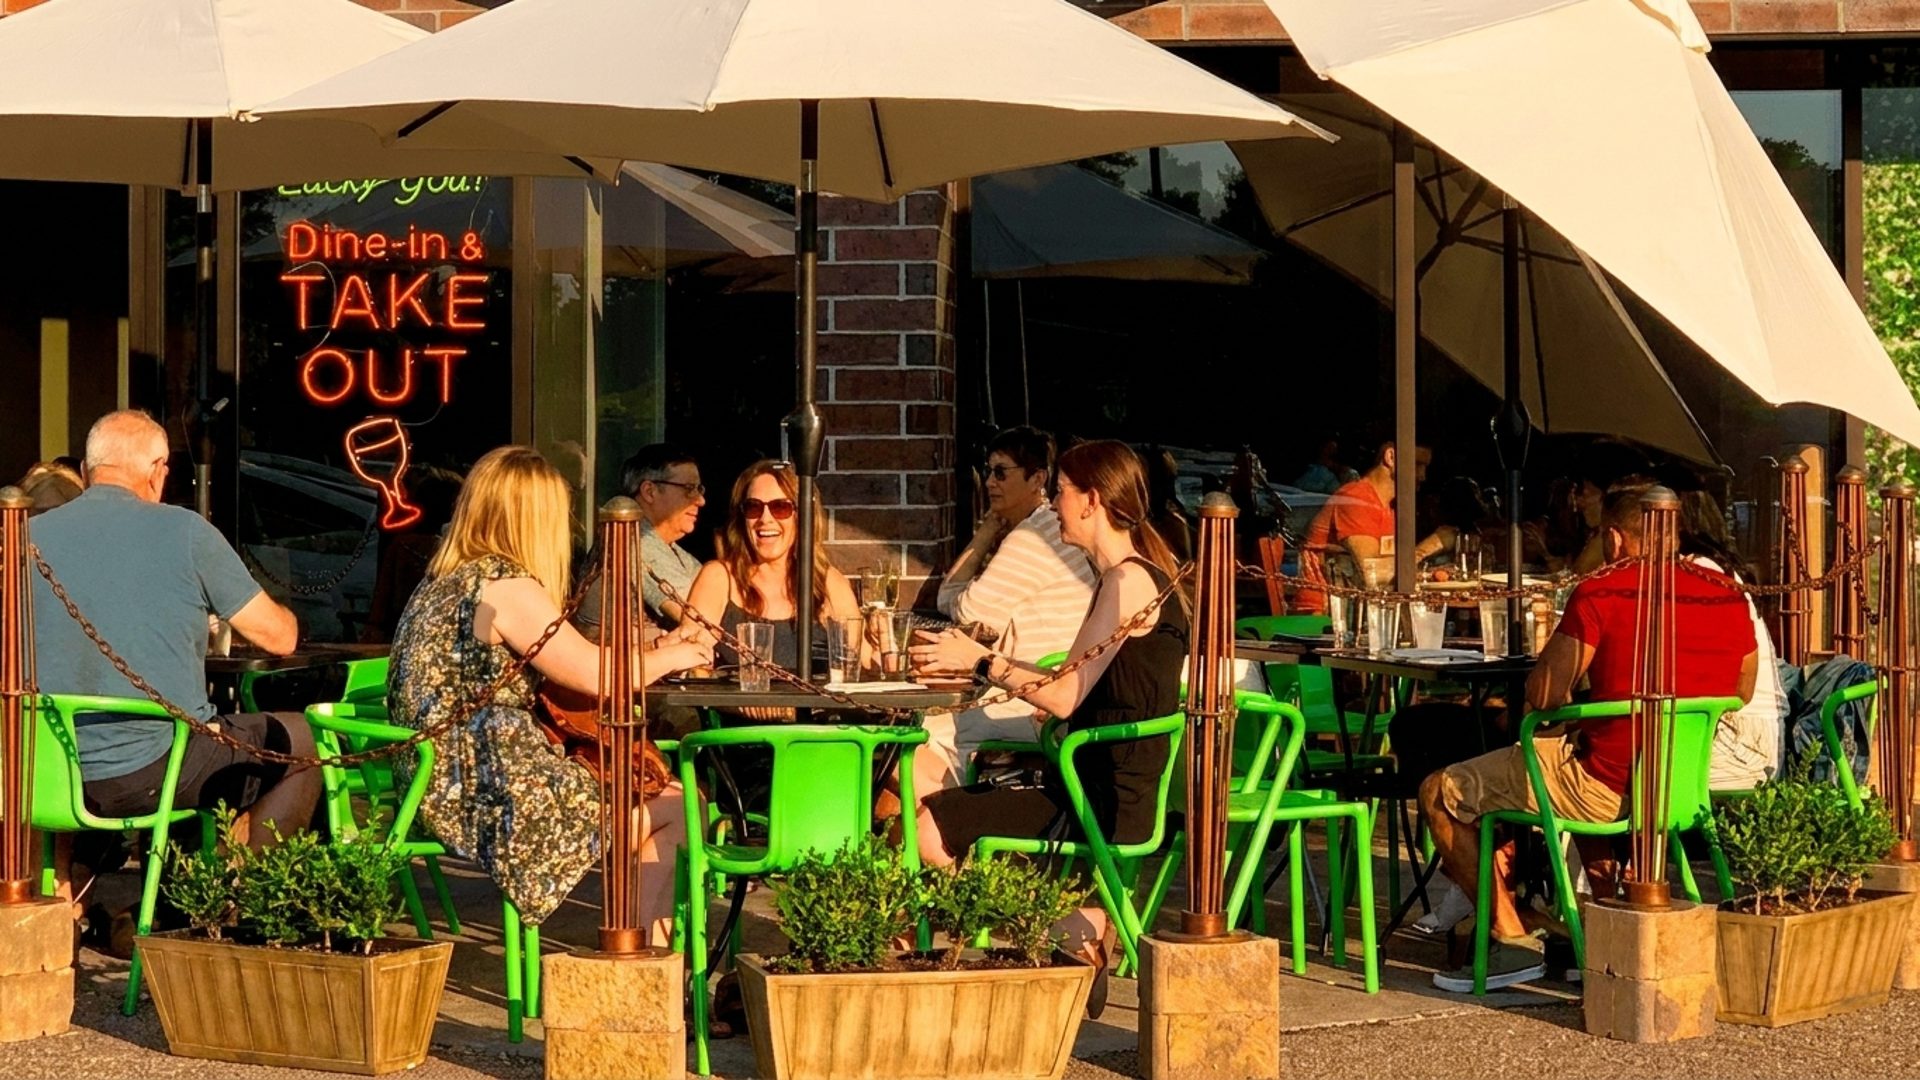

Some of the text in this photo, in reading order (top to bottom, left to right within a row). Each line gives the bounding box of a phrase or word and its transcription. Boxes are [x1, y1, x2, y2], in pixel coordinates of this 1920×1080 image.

[288, 223, 485, 261] Dine-in &
[280, 272, 489, 331] TAKE
[303, 348, 468, 403] OUT
